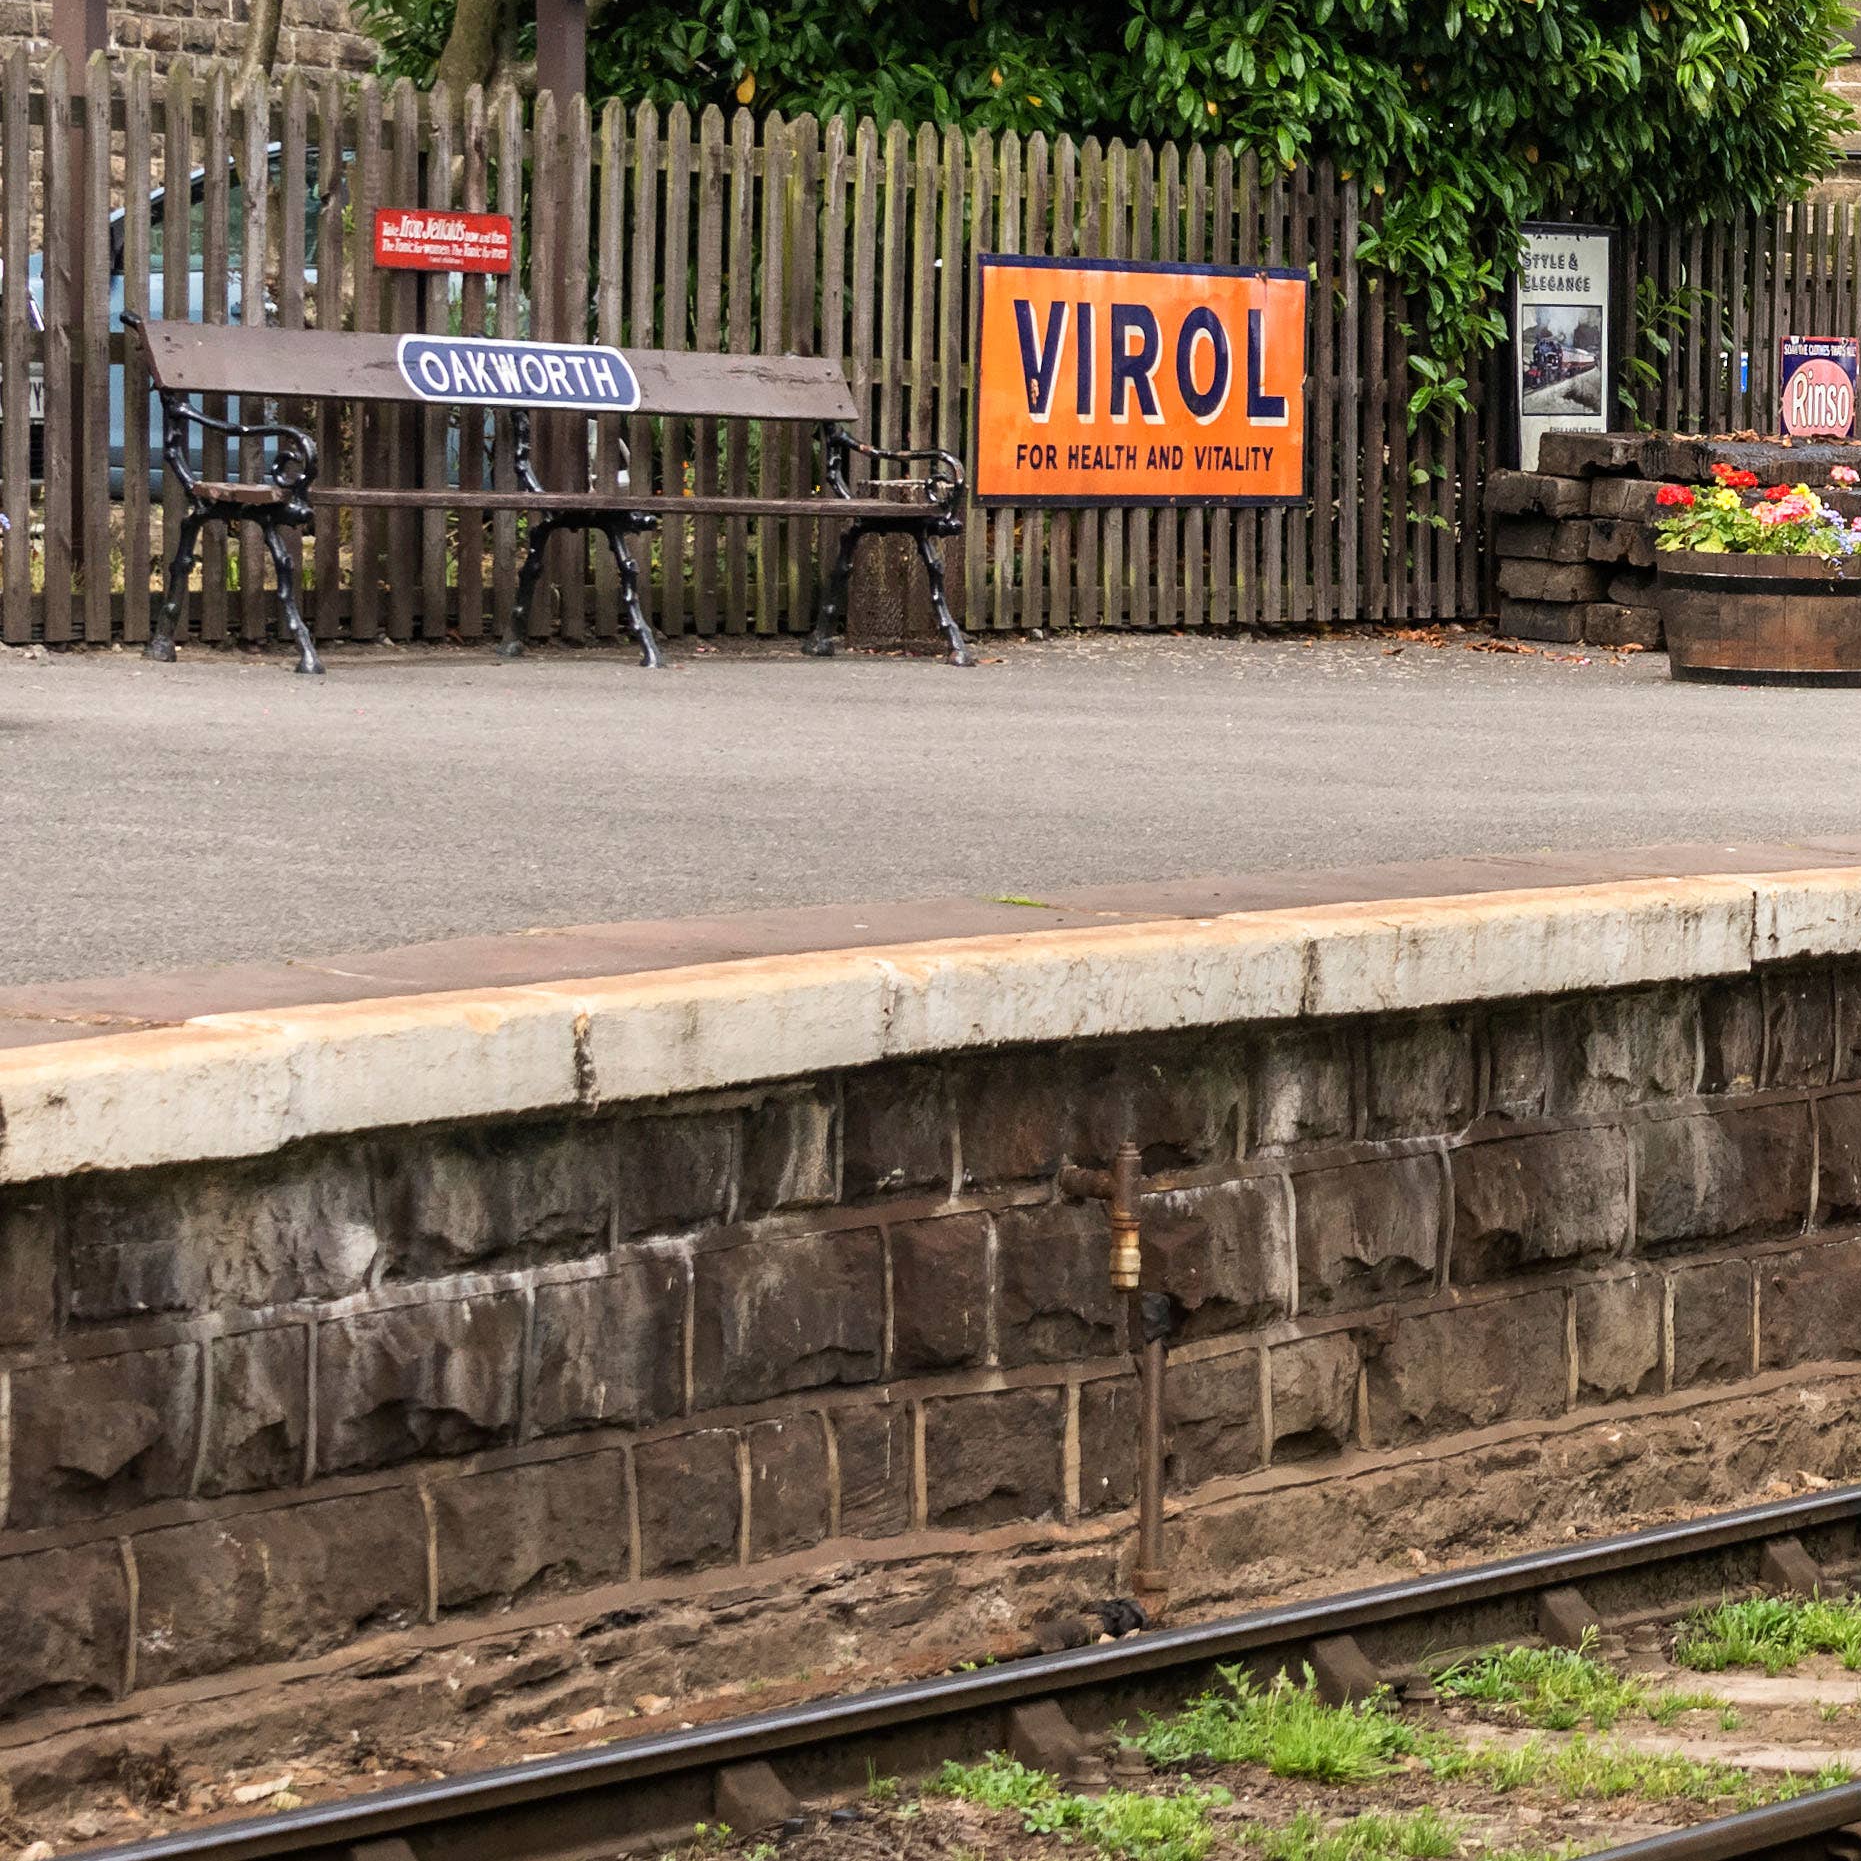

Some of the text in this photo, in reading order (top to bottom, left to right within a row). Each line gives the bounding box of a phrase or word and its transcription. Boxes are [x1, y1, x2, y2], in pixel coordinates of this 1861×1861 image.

[400, 215, 424, 239] Iron
[1522, 251, 1579, 272] STYLE &
[1522, 275, 1591, 292] ELEGANCE
[419, 350, 620, 398] OAKWORTH
[1013, 299, 1289, 427] VIROL
[1791, 369, 1850, 428] Rinso
[1016, 444, 1274, 472] FOR HEALTH AND VITALITY
